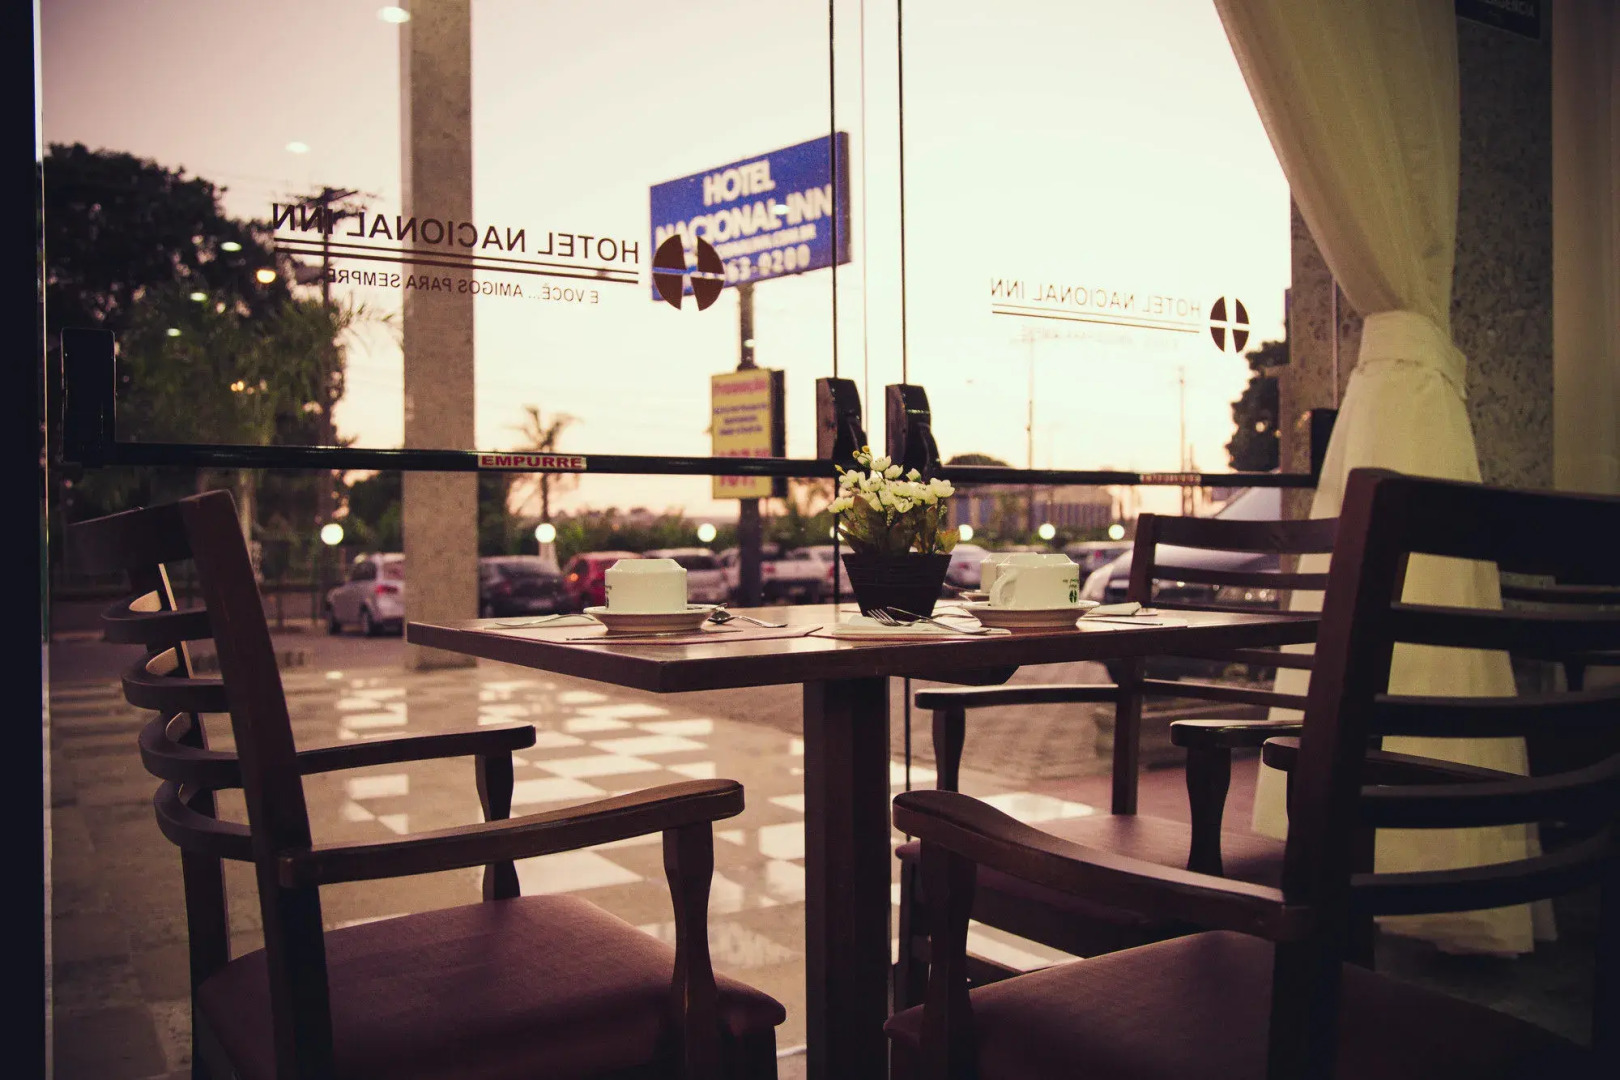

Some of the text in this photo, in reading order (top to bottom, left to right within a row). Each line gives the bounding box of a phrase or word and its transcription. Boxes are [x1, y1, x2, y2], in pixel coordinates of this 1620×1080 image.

[703, 159, 776, 207] HOTEL
[786, 184, 834, 226] INN
[481, 455, 583, 468] EMPURRE
